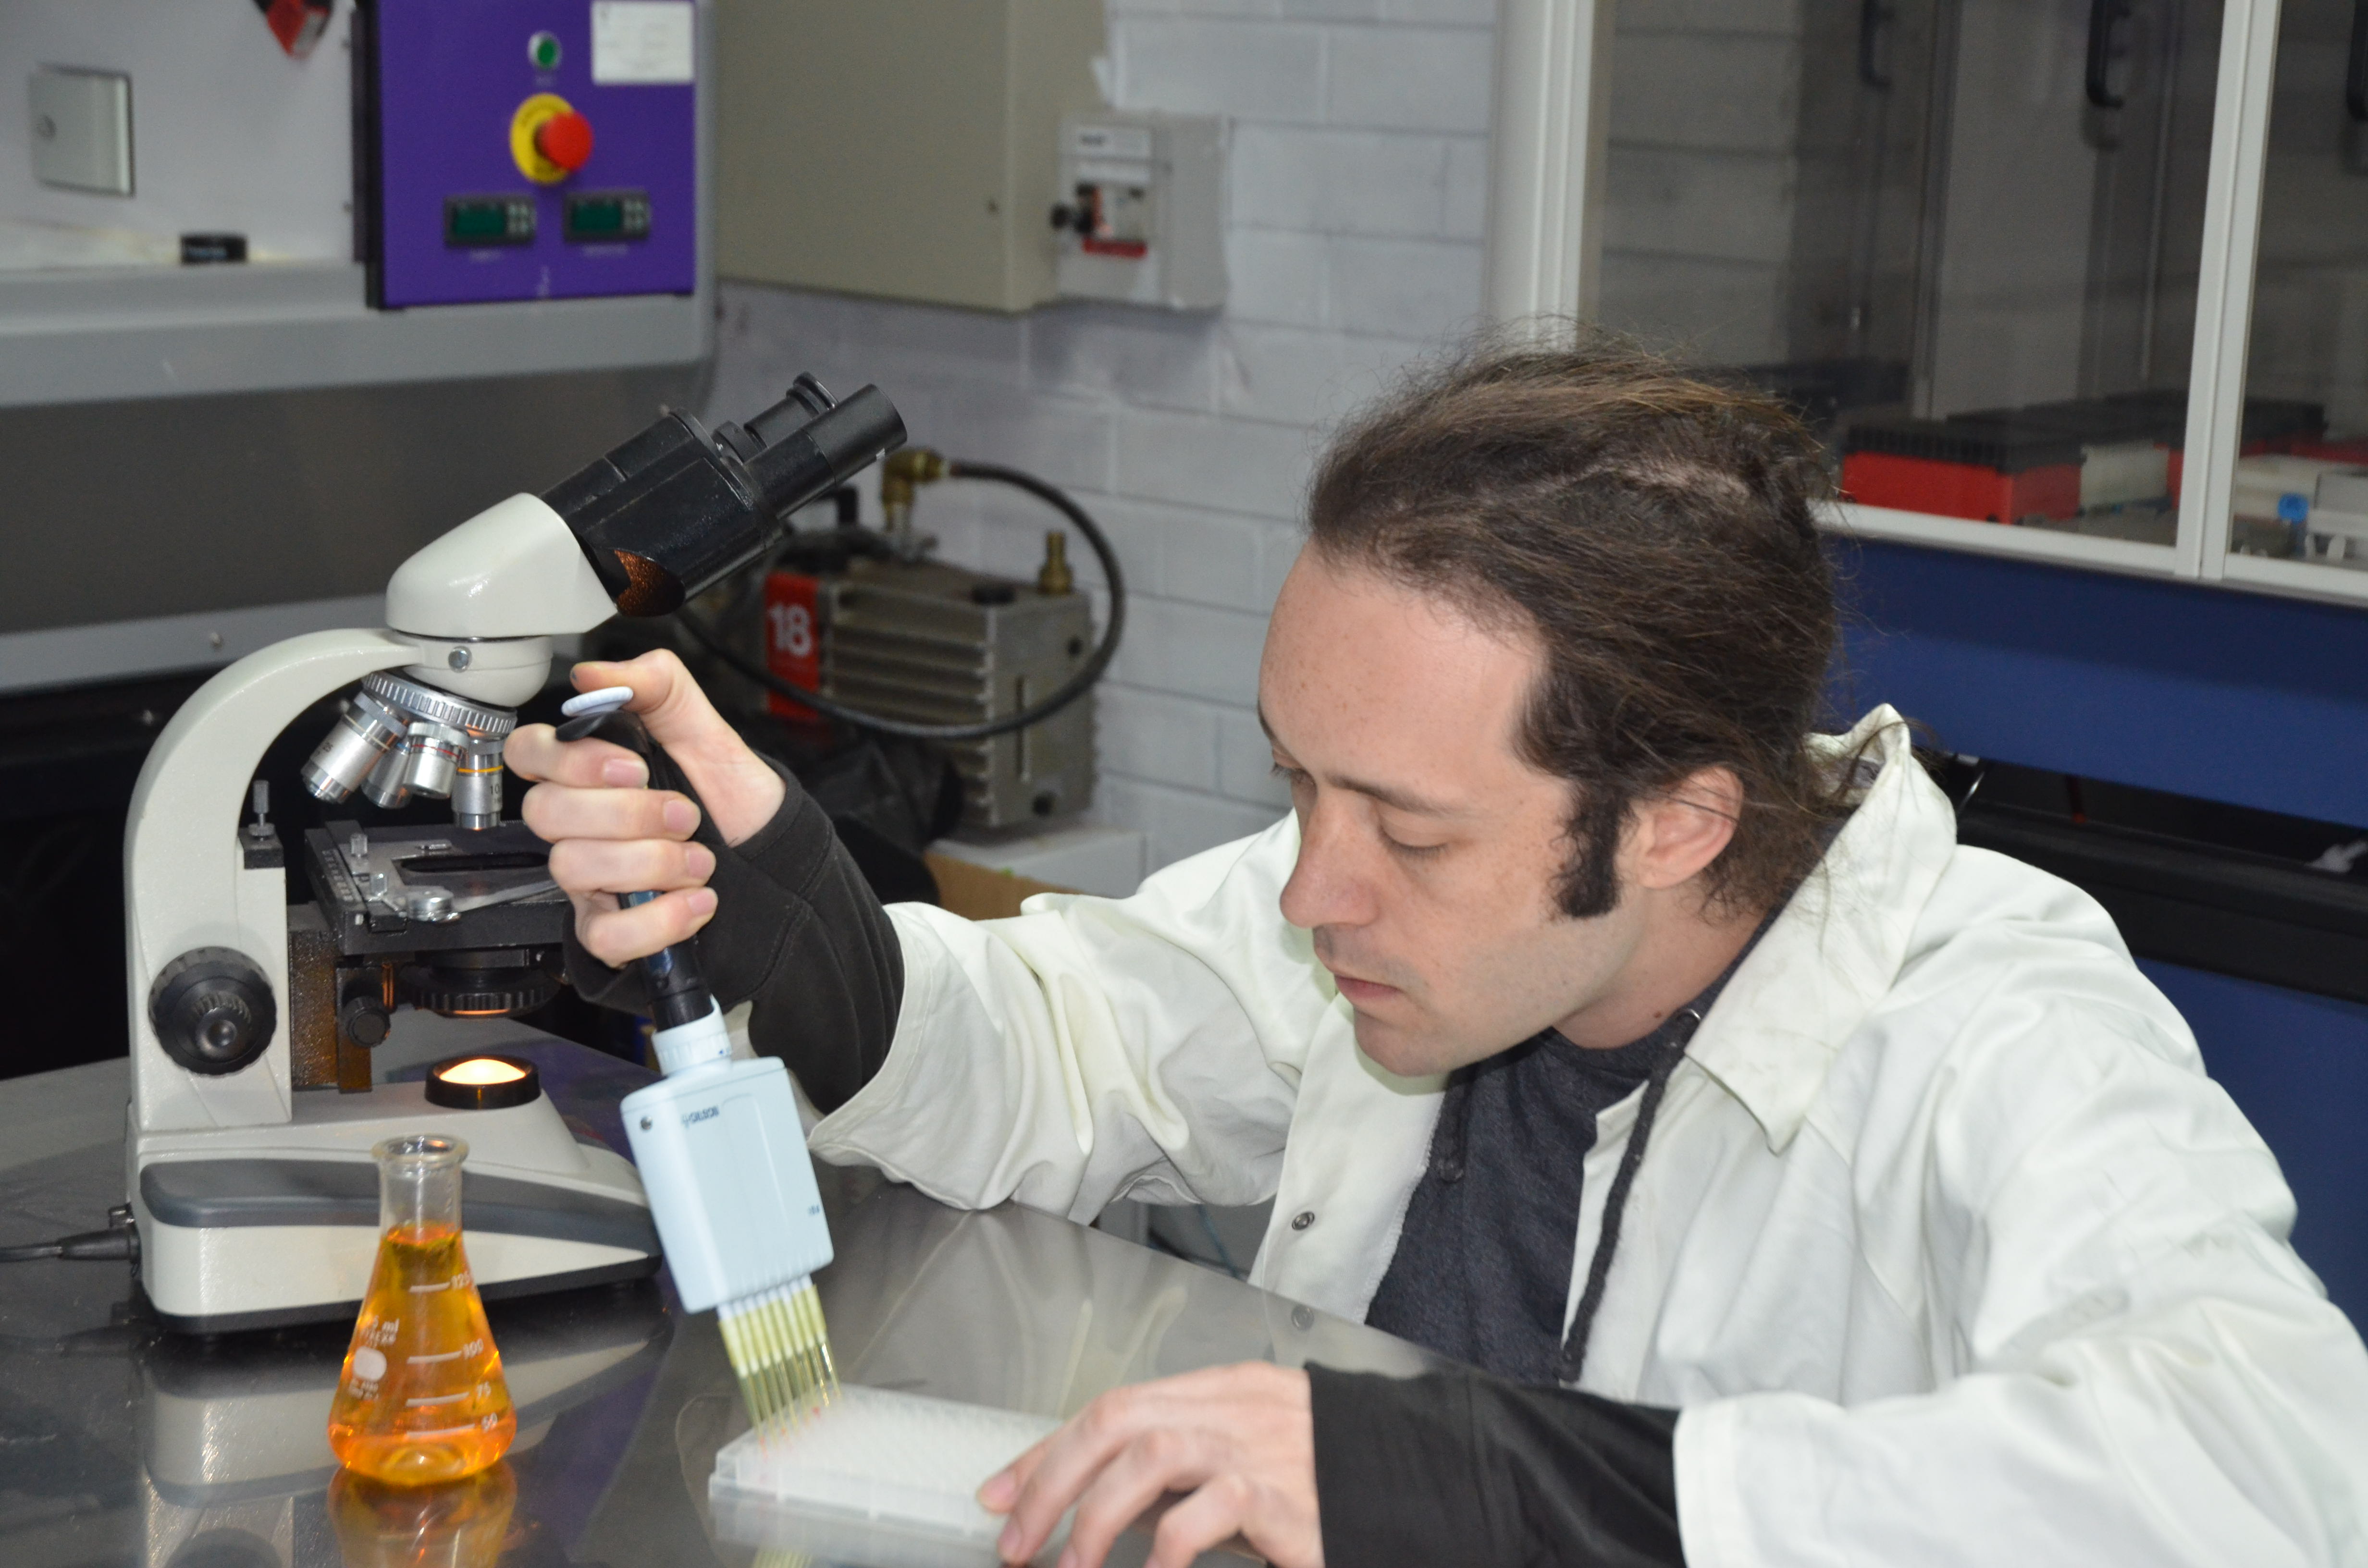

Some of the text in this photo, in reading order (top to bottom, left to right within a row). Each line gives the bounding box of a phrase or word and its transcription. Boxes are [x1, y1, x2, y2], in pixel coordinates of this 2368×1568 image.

[770, 604, 811, 657] 18
[450, 1271, 470, 1291] 125
[462, 1337, 484, 1360] 100
